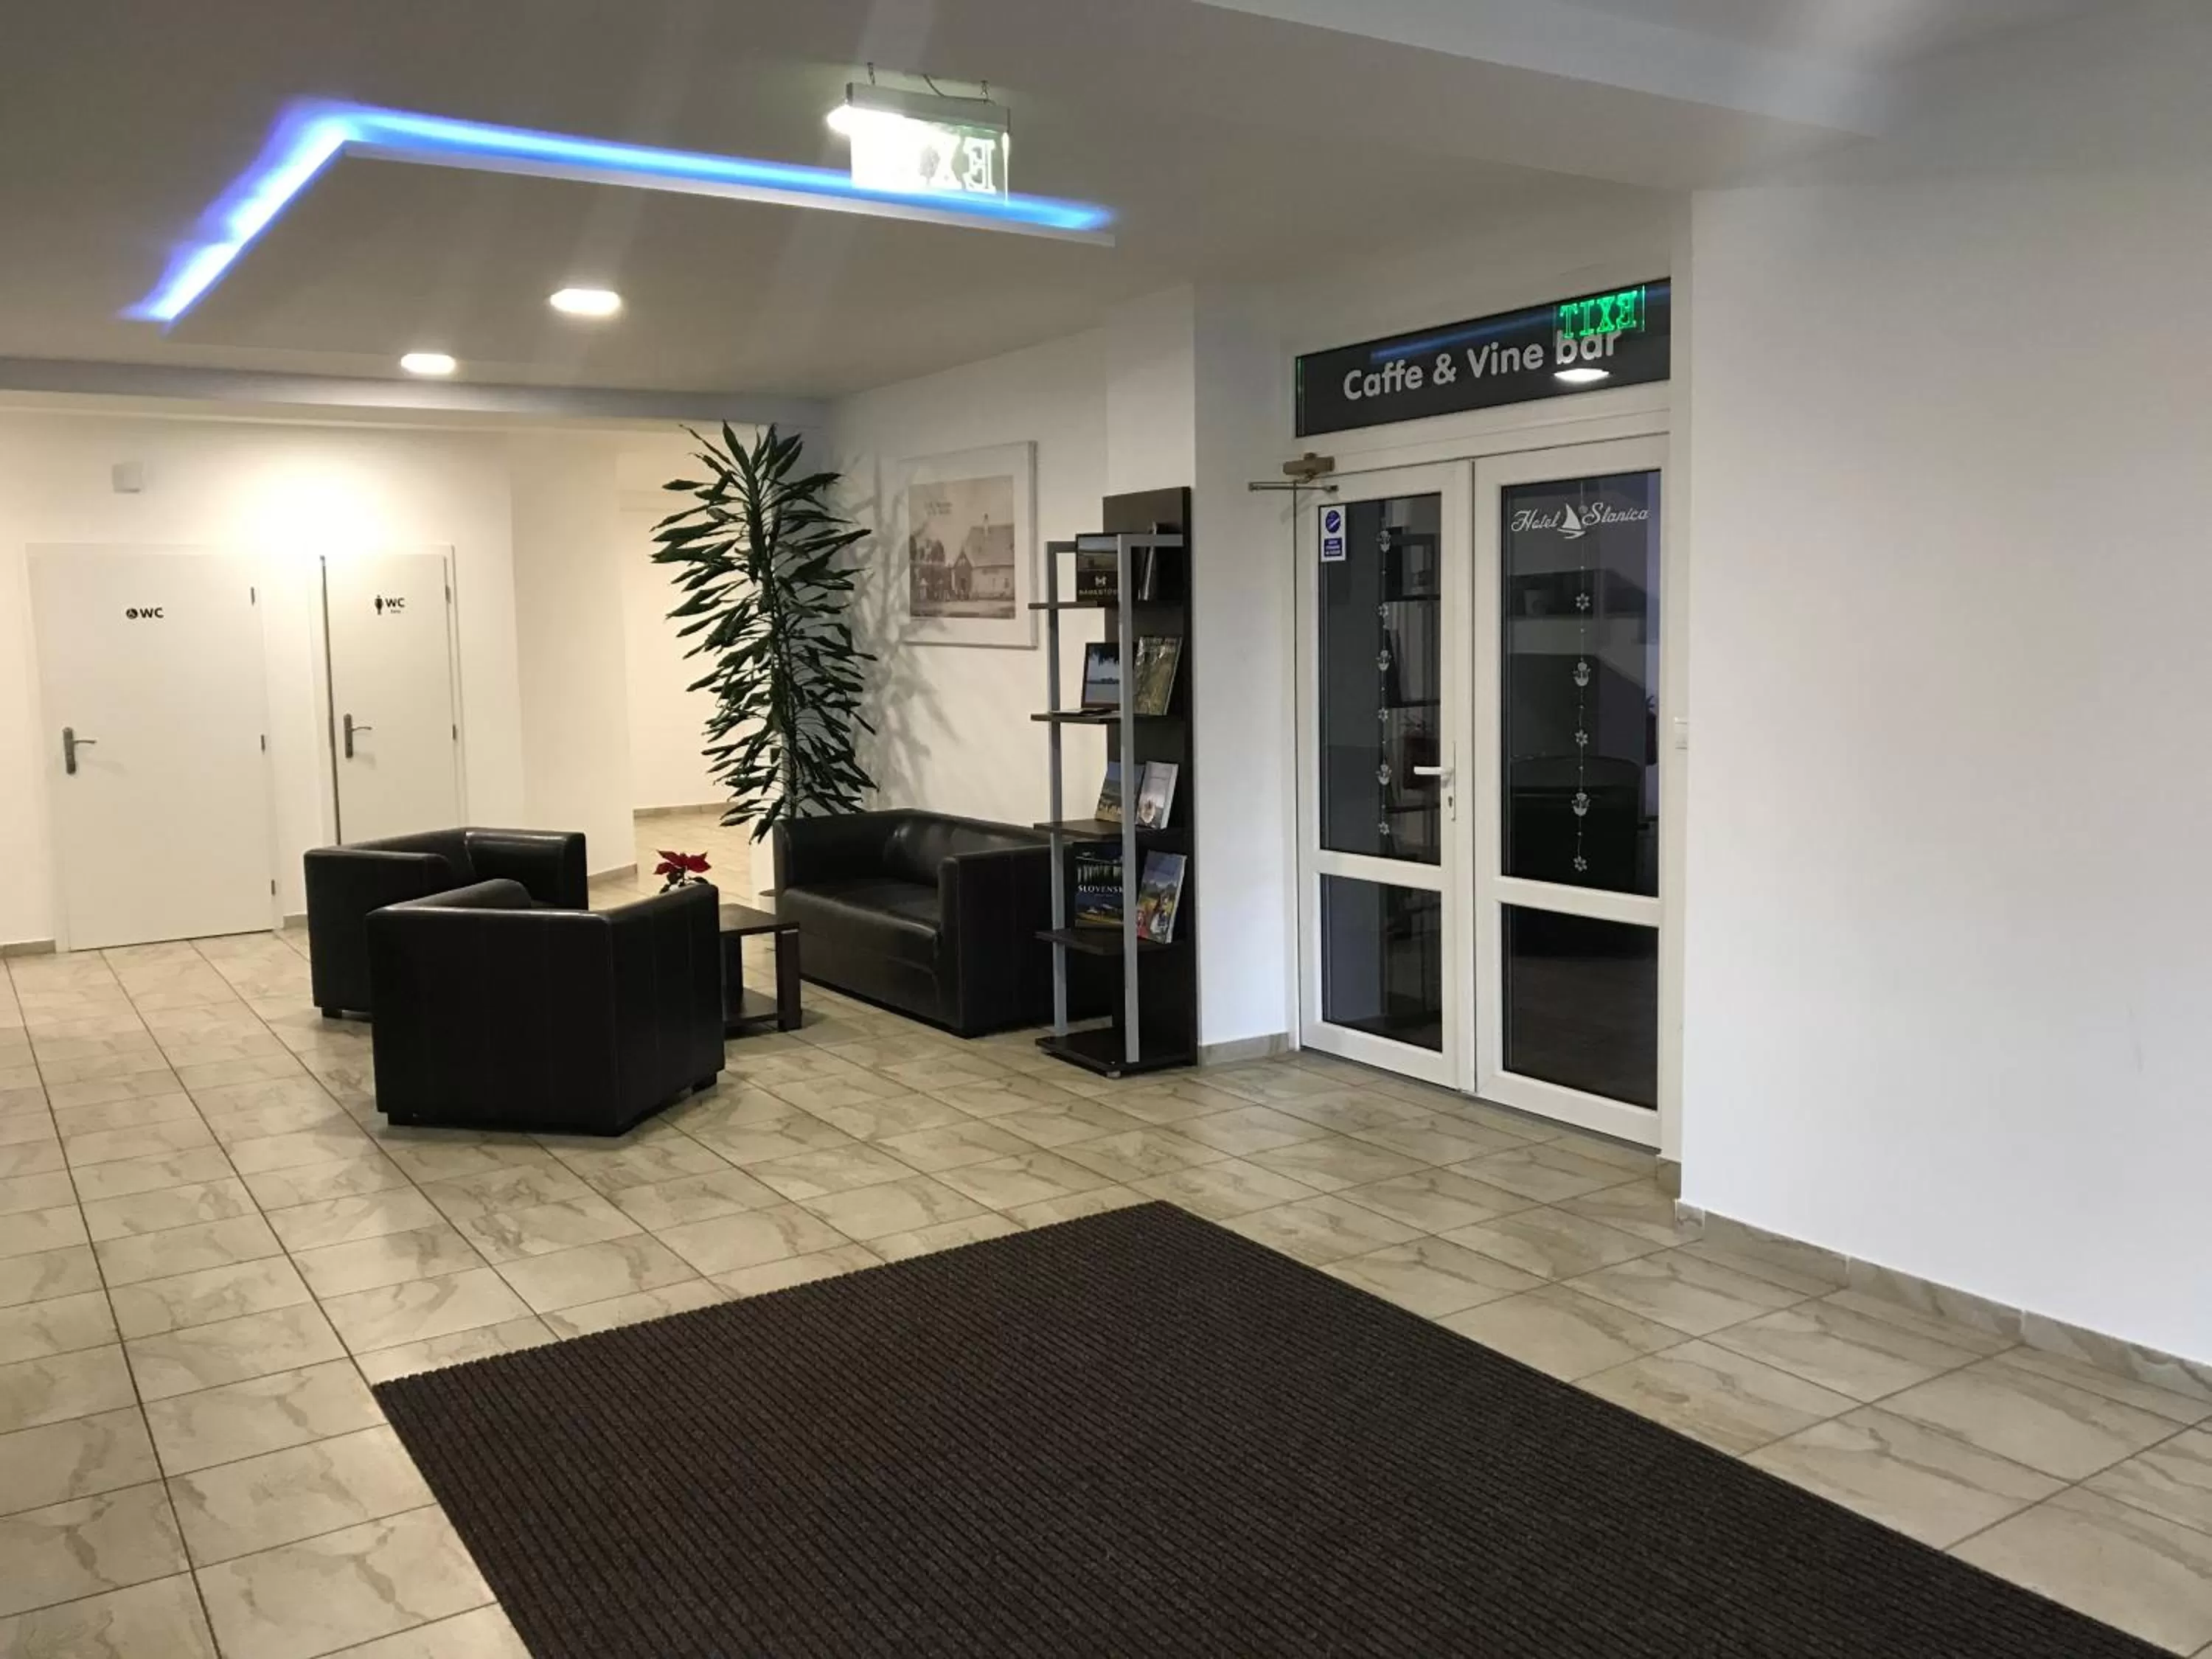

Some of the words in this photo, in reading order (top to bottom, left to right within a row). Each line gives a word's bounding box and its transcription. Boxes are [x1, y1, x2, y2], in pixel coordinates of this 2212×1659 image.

[1343, 359, 1423, 400] Caffe
[1433, 353, 1456, 385] &
[1467, 341, 1544, 378] Vine
[1557, 330, 1622, 364] bar
[1511, 509, 1561, 532] Hotel
[385, 597, 405, 608] WC
[139, 607, 164, 619] WC
